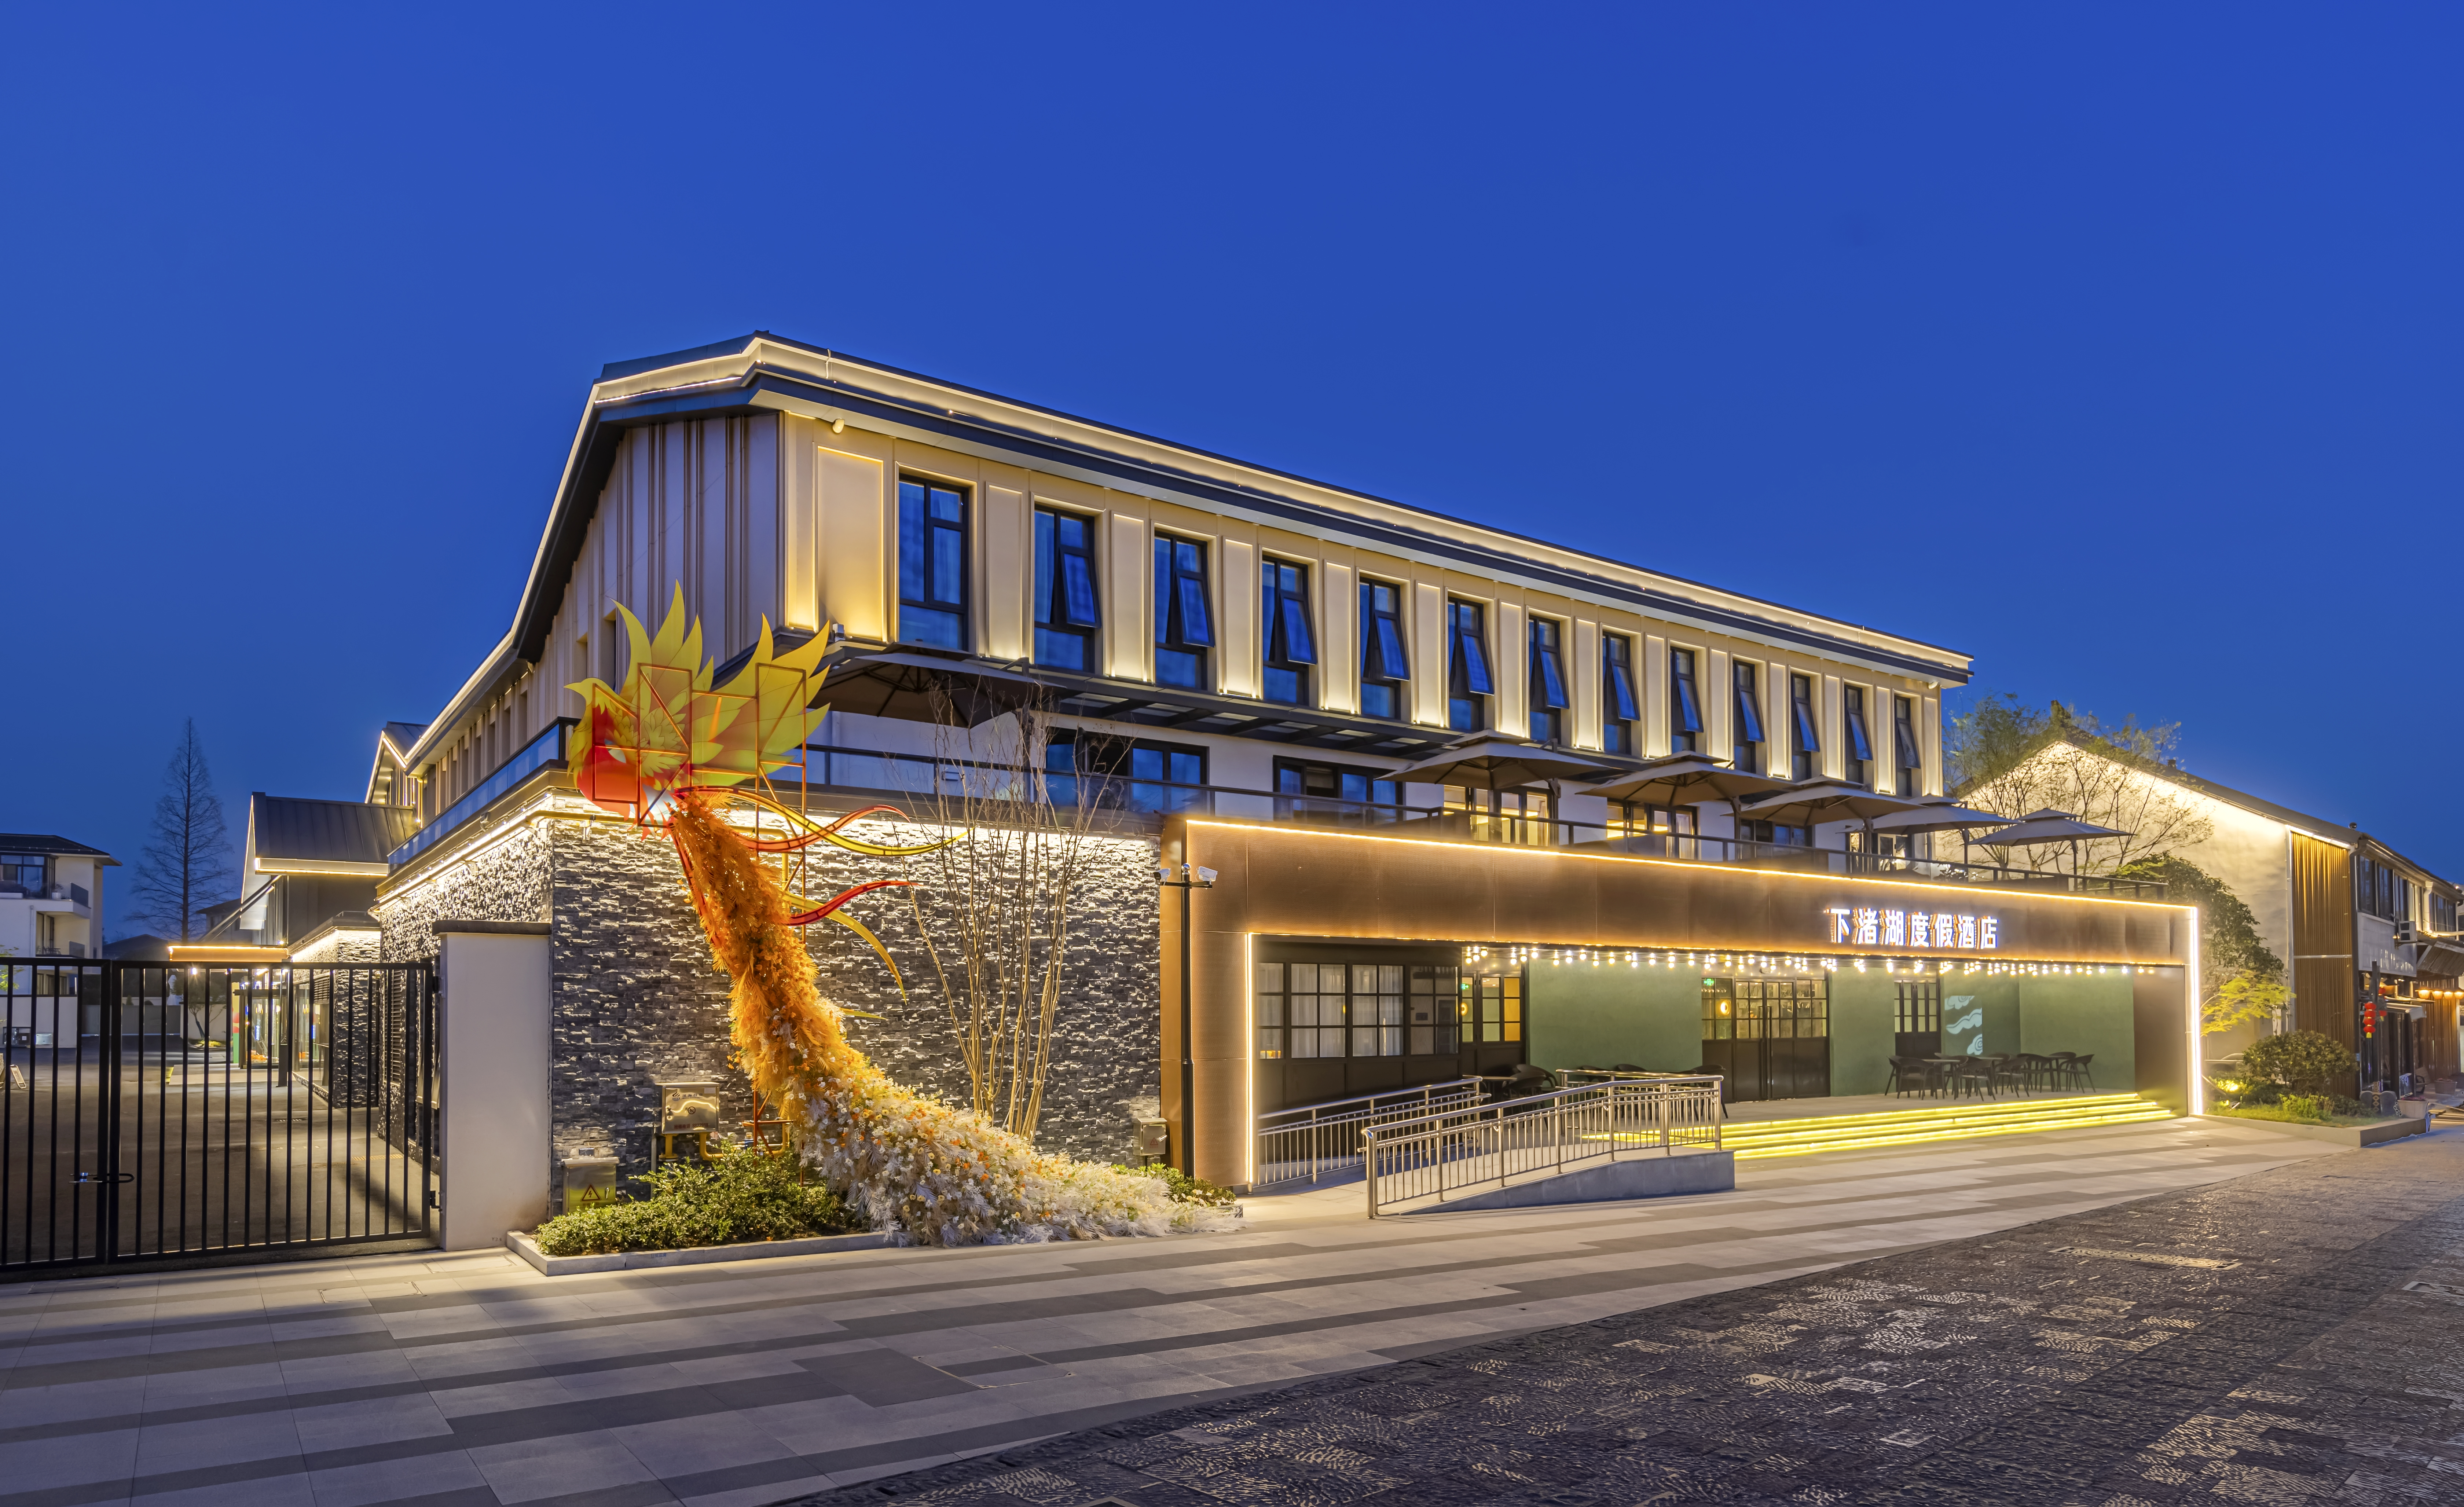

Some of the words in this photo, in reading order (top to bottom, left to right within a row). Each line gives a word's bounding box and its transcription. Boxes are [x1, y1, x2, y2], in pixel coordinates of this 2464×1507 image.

[1826, 908, 1998, 949] 下渚湖度假酒店
